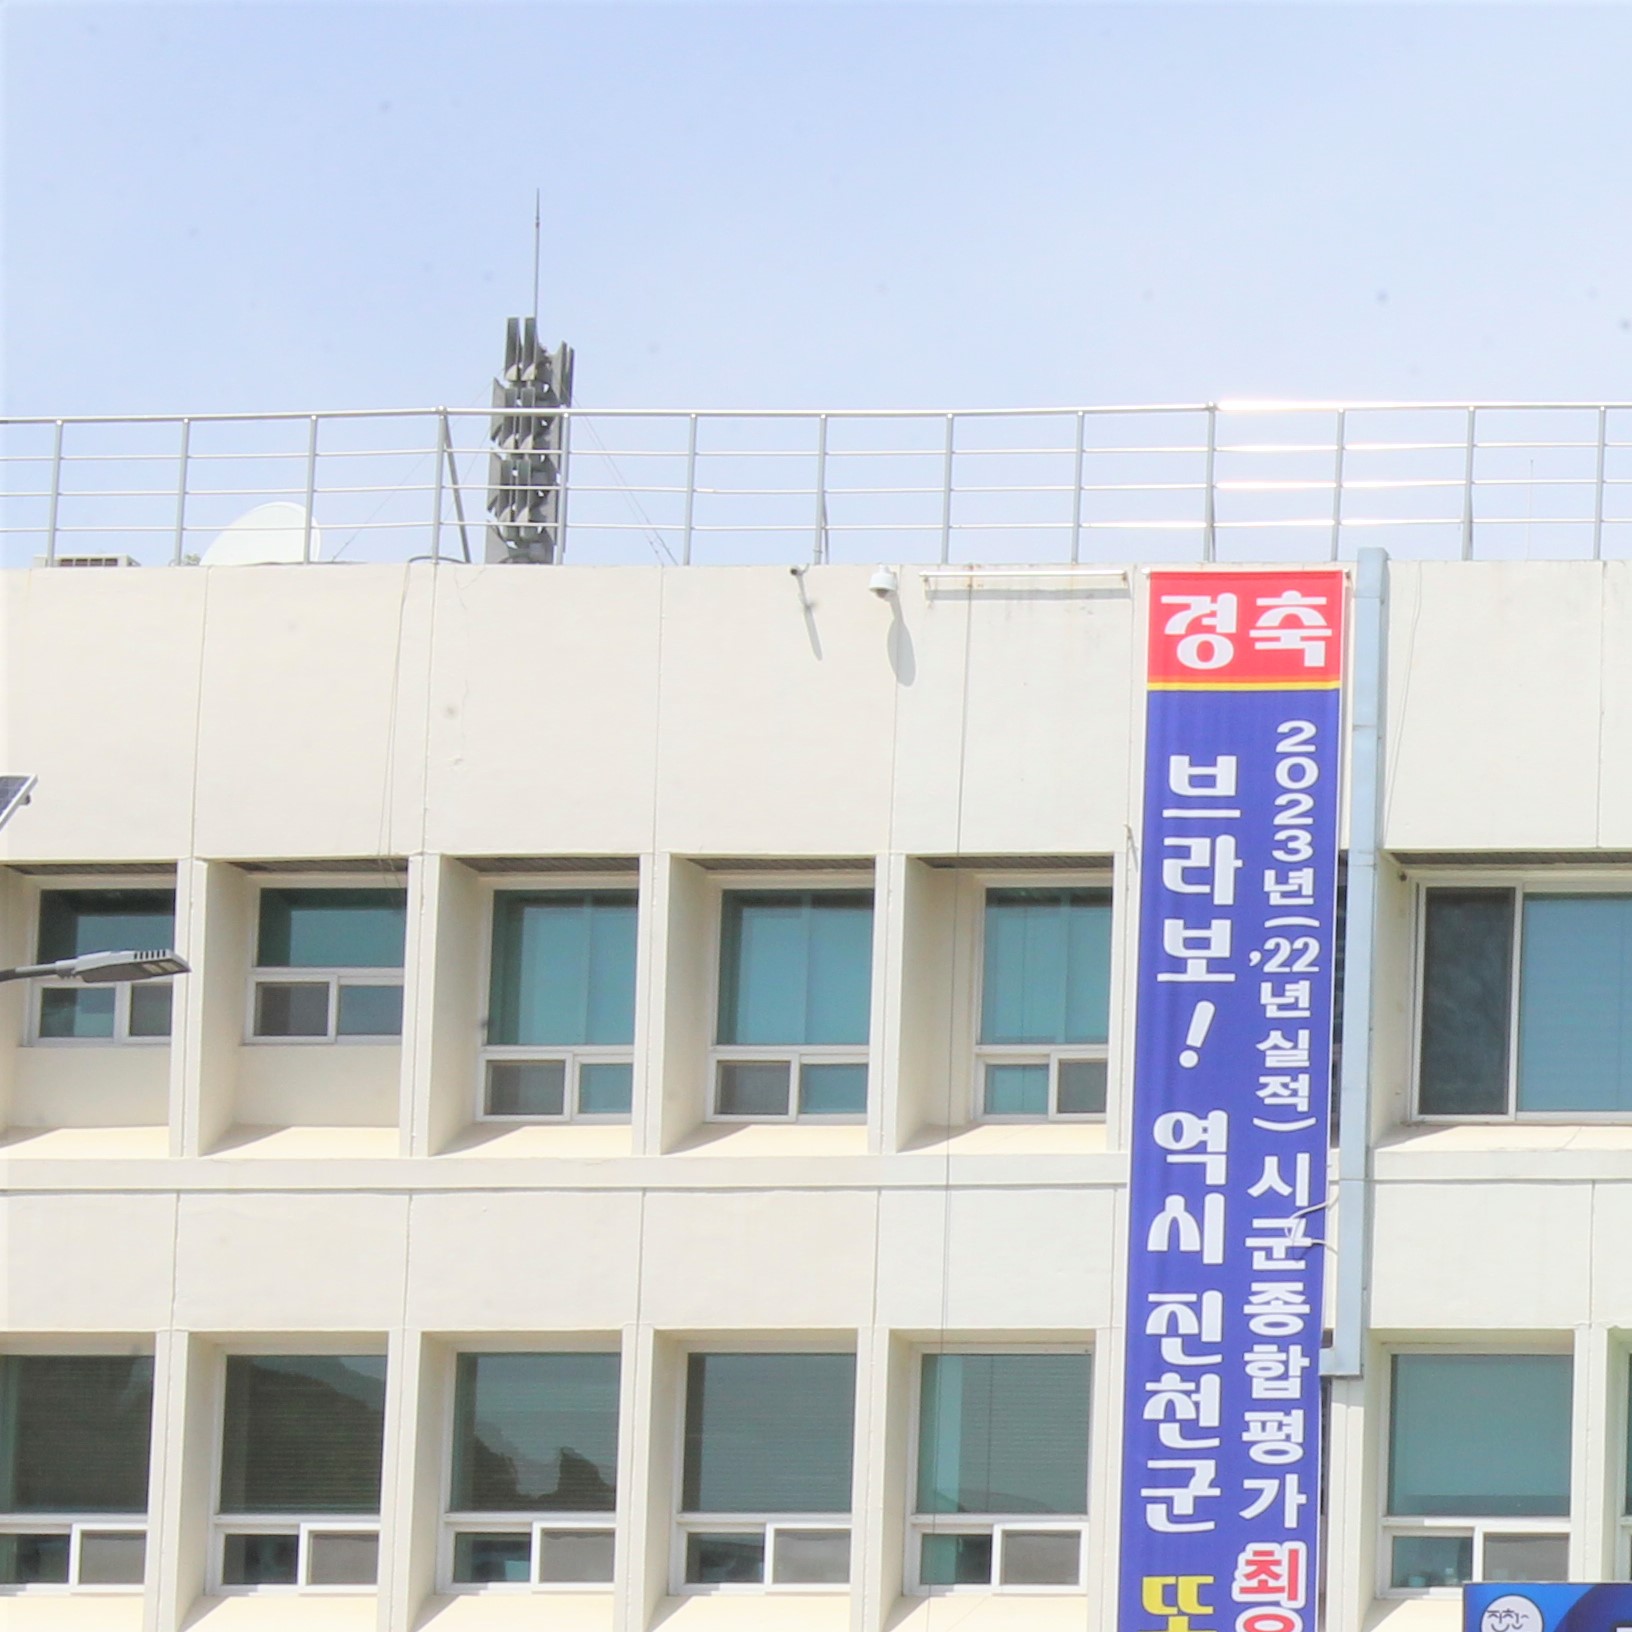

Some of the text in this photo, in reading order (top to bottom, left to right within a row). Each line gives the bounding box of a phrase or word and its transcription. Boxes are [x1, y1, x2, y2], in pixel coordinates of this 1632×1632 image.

[1161, 591, 1332, 669] 경축
[1157, 754, 1243, 1068] 브라보!
[1147, 1109, 1228, 1264] 역시
[1141, 1289, 1223, 1533] 진천군
[1239, 1152, 1313, 1529] 시군종합평가
